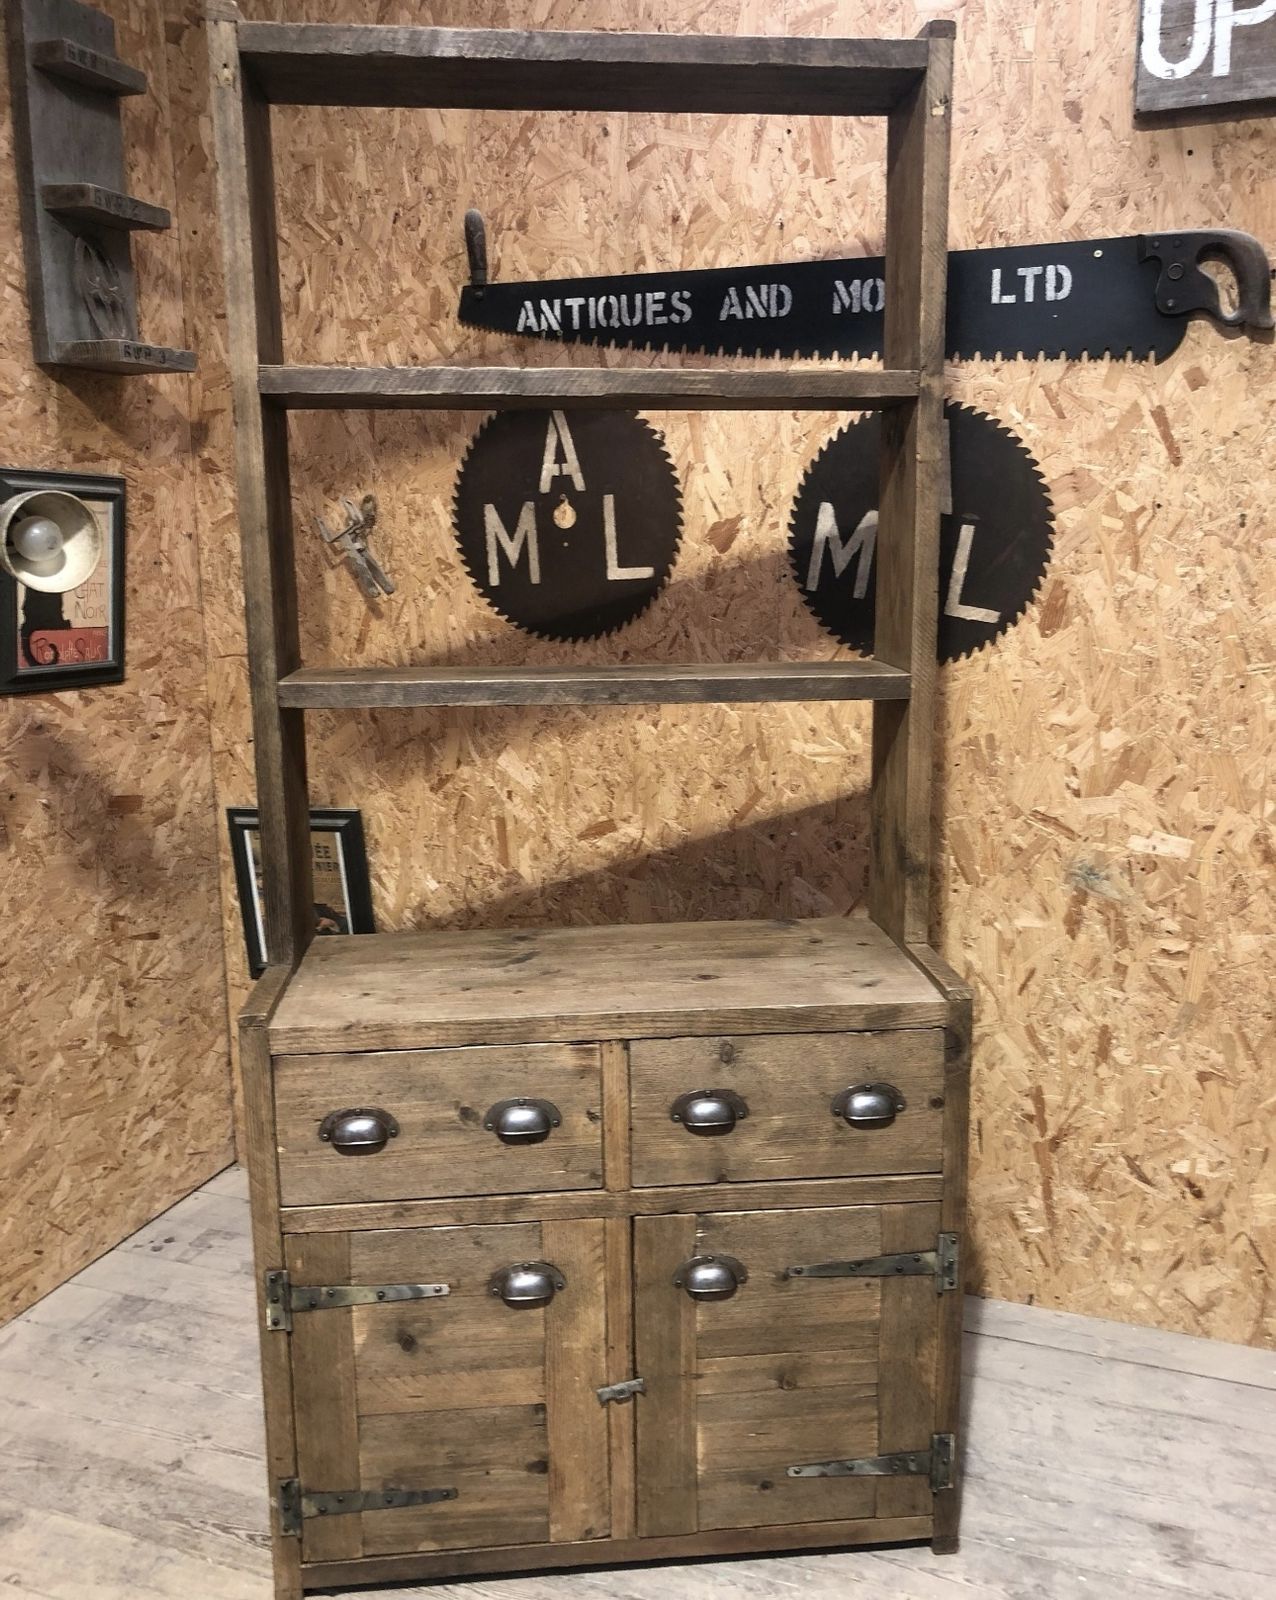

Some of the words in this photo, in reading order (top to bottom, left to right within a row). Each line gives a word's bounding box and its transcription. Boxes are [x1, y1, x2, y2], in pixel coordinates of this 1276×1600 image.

[516, 290, 693, 334] ANTIQUES
[719, 283, 793, 321] AND
[991, 264, 1073, 304] LTD
[539, 410, 586, 493] A
[484, 501, 541, 586] M
[603, 494, 655, 580] L
[943, 524, 1001, 624] L
